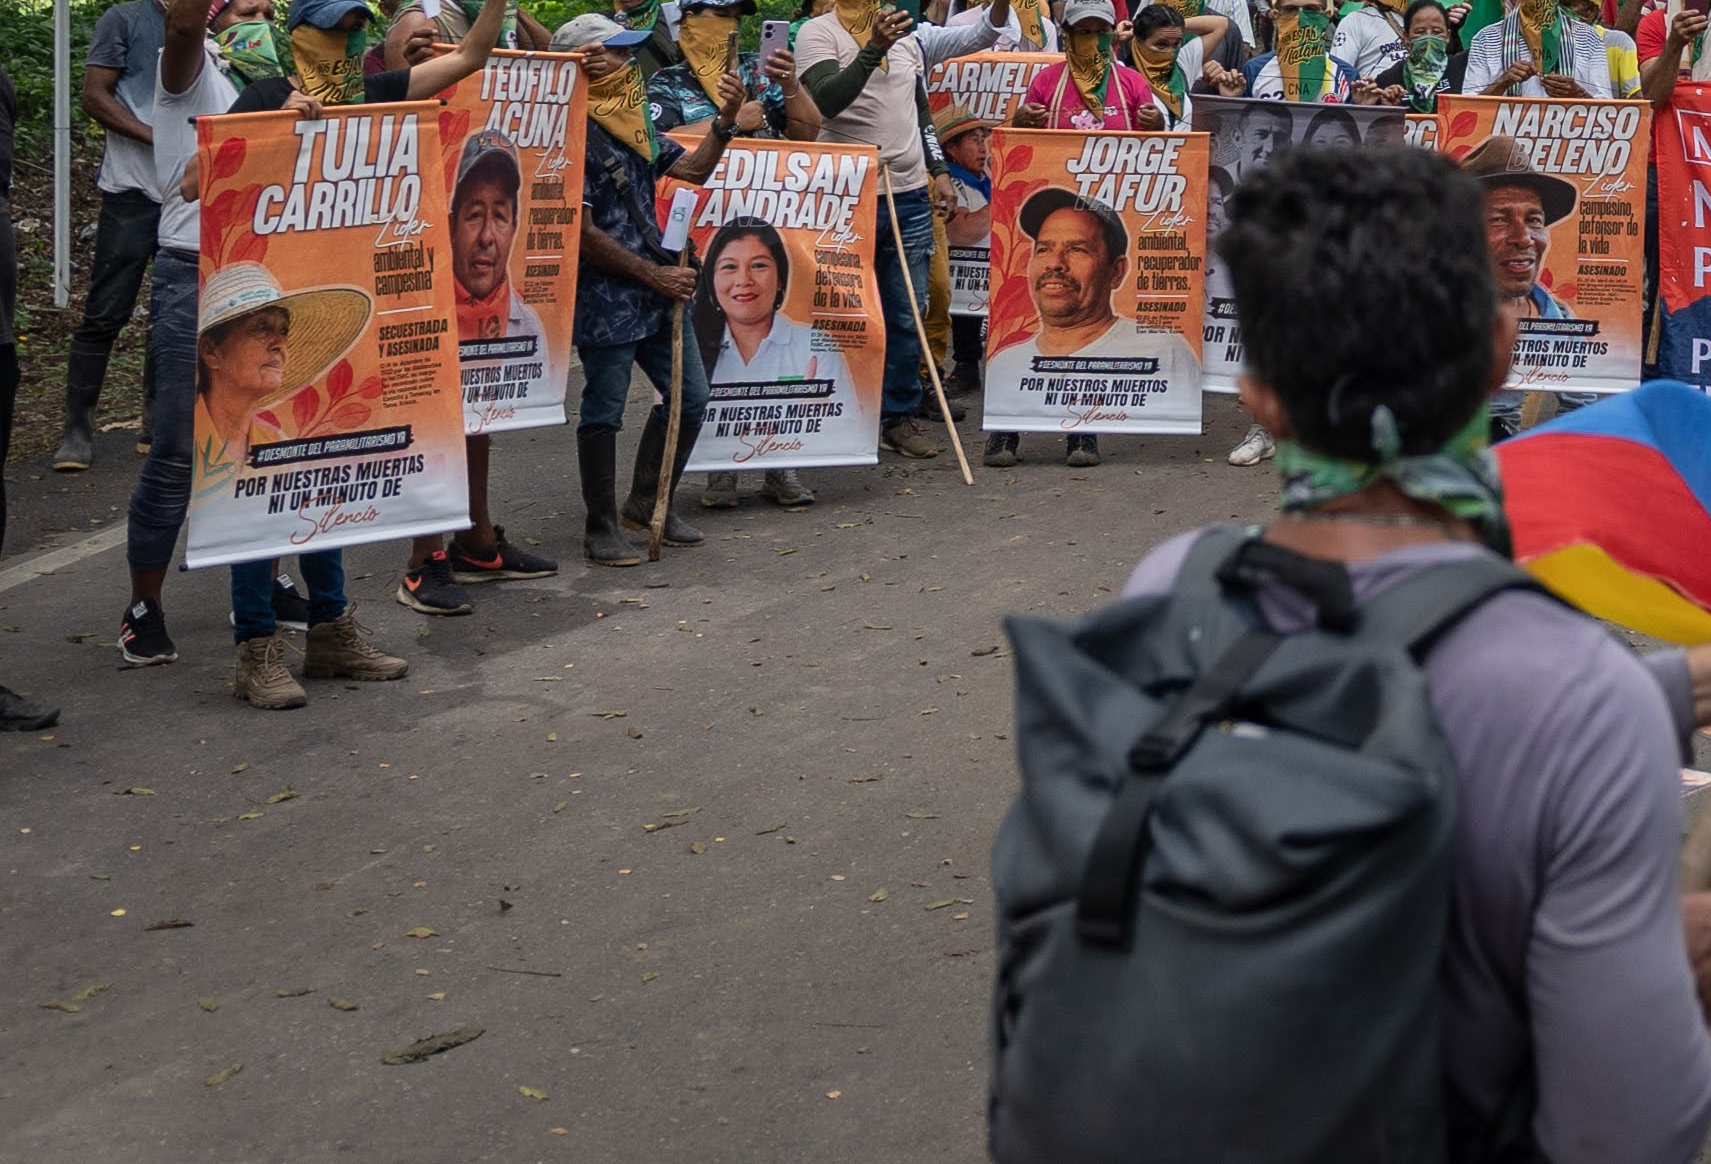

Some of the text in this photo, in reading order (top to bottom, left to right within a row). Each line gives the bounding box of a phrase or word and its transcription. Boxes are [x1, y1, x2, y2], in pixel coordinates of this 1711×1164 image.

[1288, 82, 1311, 96] CNA
[1491, 102, 1641, 140] NARCISO
[293, 113, 419, 183] TULIA
[1066, 135, 1188, 175] JORGE
[702, 148, 869, 197] EDILSAN
[1074, 172, 1188, 213] TAFUR
[252, 174, 422, 236] CARRILLO
[695, 188, 860, 233] ANDRADE
[1579, 199, 1635, 220] campesino,
[1579, 215, 1639, 237] defensor de
[1137, 231, 1190, 255] ambiental,
[1578, 235, 1610, 255] la vida
[373, 240, 435, 274] ambiental y
[1137, 249, 1202, 274] recuperador
[815, 264, 863, 289] defensora
[1136, 270, 1191, 291] de tierras.
[1576, 264, 1627, 277] ASESINADO
[375, 269, 433, 300] campesina
[955, 278, 966, 291] NI
[813, 286, 862, 309] de la vida
[1135, 301, 1187, 313] ASESINADO
[379, 319, 448, 341] SECUESTRADA
[811, 319, 867, 333] ASESINADA
[1203, 324, 1226, 344] OR
[378, 343, 385, 359] Y
[386, 336, 440, 357] ASESINADA
[1224, 344, 1242, 363] NI
[1512, 339, 1609, 356] STROS MUERTOS
[1511, 352, 1588, 368] N MINUTO DE
[503, 362, 543, 383] MUERTOS
[517, 381, 529, 398] DE
[1020, 377, 1169, 394] POR NUESTROS MUERTOS
[1044, 392, 1148, 407] NI UN MINUTO DE
[701, 402, 844, 422] OR NUESTRAS MUERTAS
[715, 417, 822, 438] NI UN MINUTO DE
[257, 443, 307, 463] #DESMONTE
[307, 439, 323, 455] DEL
[396, 430, 407, 445] YA
[732, 428, 805, 464] Silencio
[235, 453, 425, 499] POR NUESTRAS MUERTAS
[268, 477, 403, 515] NI UN MINUTO DE
[289, 493, 381, 545] Silencio
